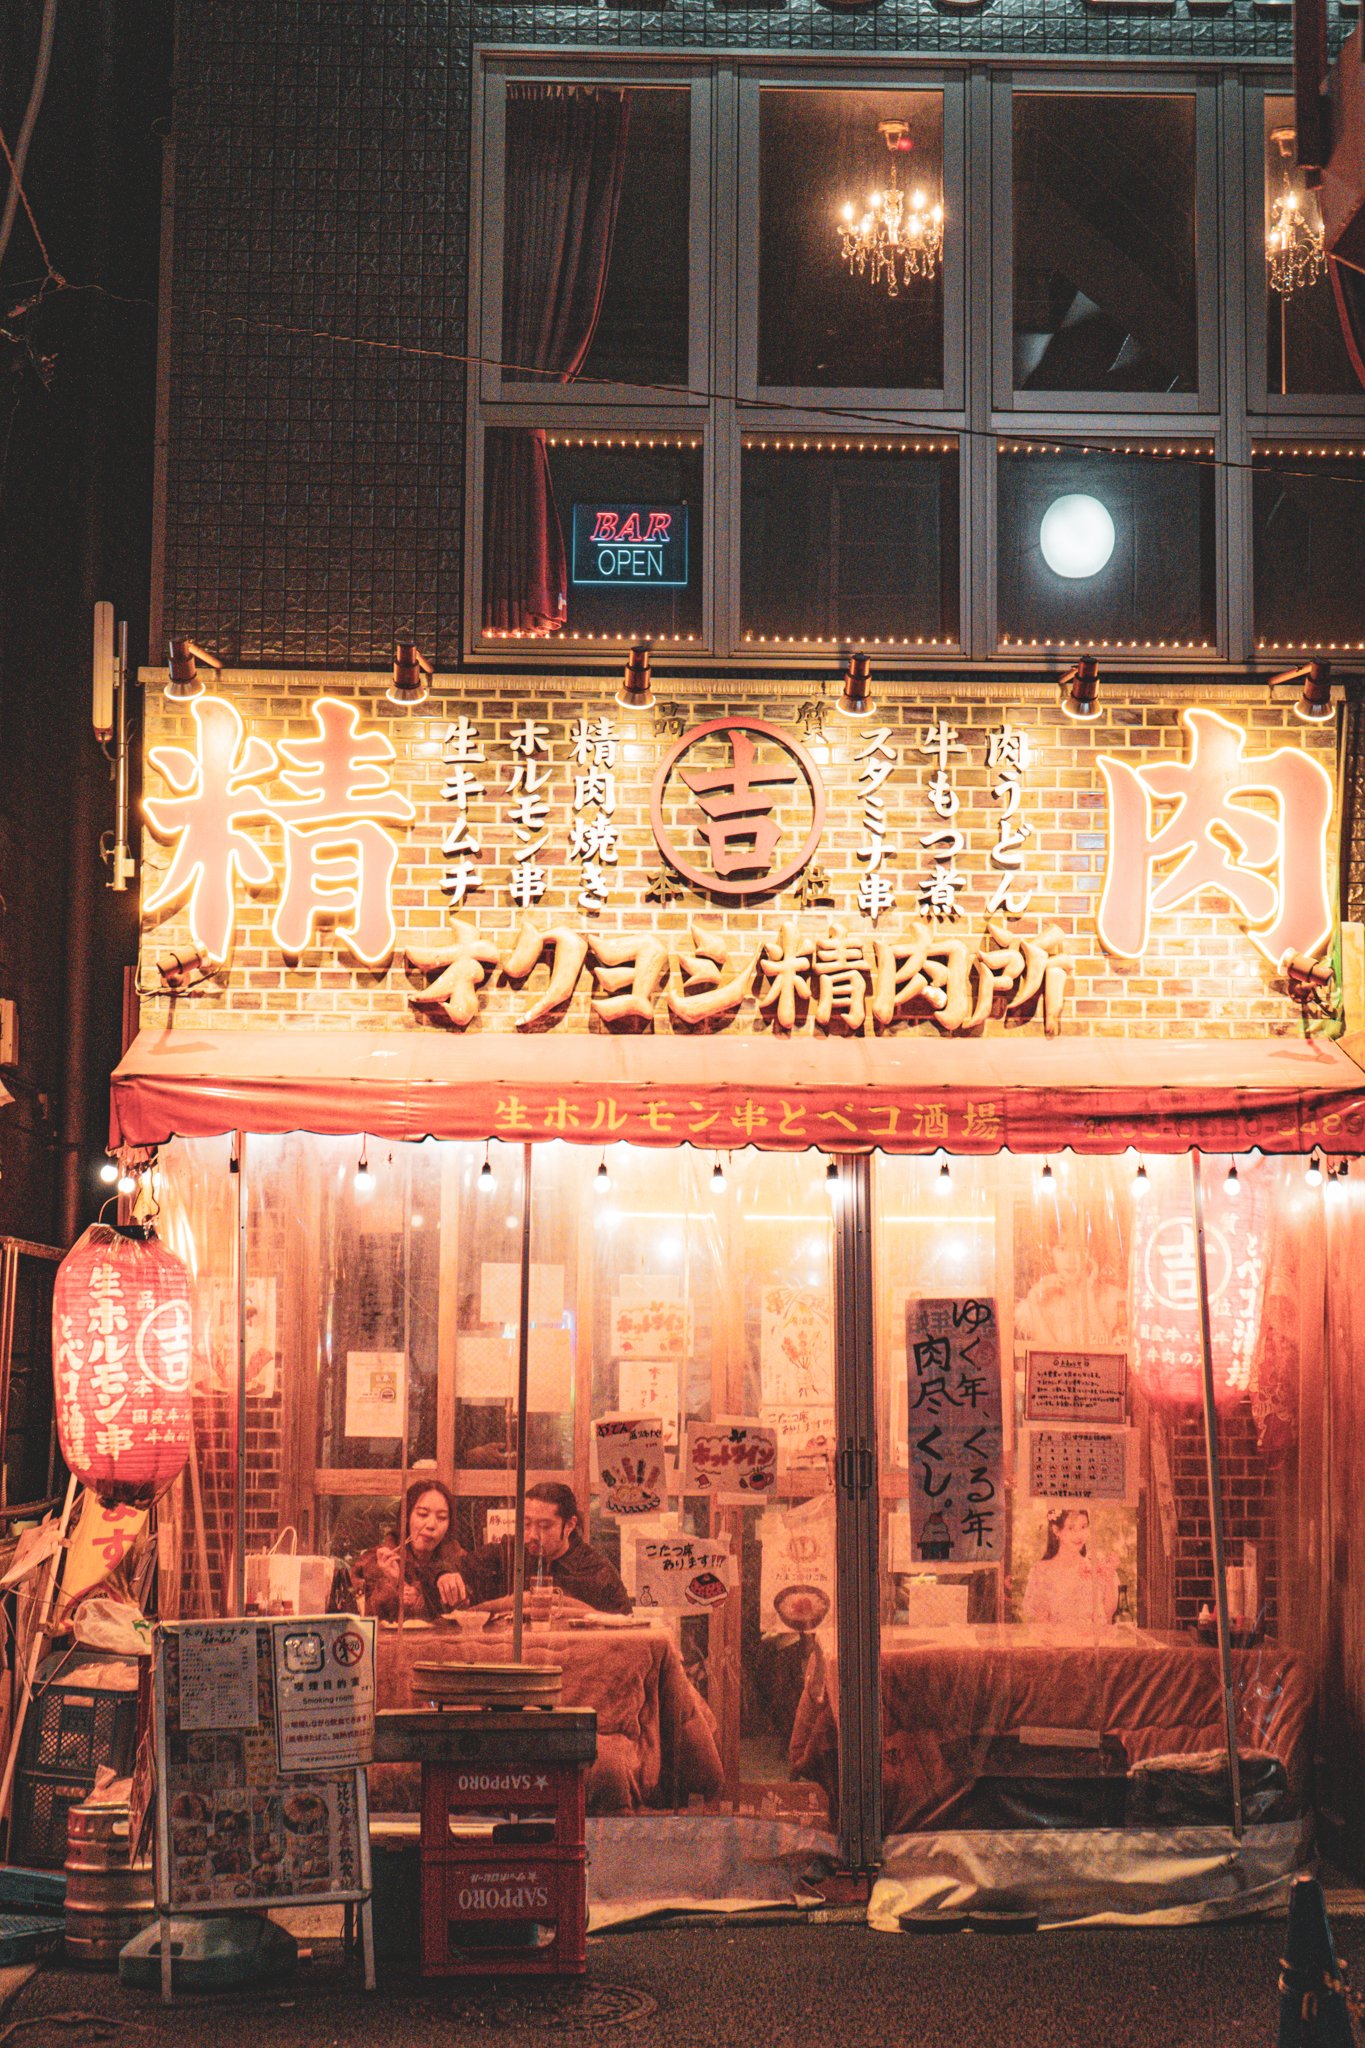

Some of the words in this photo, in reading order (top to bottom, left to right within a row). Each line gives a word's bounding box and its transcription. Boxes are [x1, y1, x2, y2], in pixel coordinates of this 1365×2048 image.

[589, 512, 672, 542] BAR
[598, 549, 663, 576] OPEN
[143, 698, 416, 962] 精
[1096, 707, 1335, 961] 肉
[439, 716, 486, 908] 生キムチ
[505, 718, 553, 908] ホルモン串
[568, 716, 620, 909] 精肉焼き
[678, 730, 798, 876] 吉
[854, 727, 898, 920] スタミナ串
[919, 720, 968, 917] 牛もつ煮
[985, 724, 1034, 914] 肉うどん
[404, 918, 1075, 1038] オクヨン精肉所
[494, 1096, 1002, 1139] 生ホルモン串とベコ酒場
[88, 1263, 135, 1461] 生ホルモン串
[152, 1307, 192, 1383] 吉
[692, 1443, 776, 1467] ホットワイン
[646, 1542, 695, 1557] こたつ席
[458, 1774, 532, 1791] SAPPORO
[458, 1888, 548, 1910] SAPPORO
